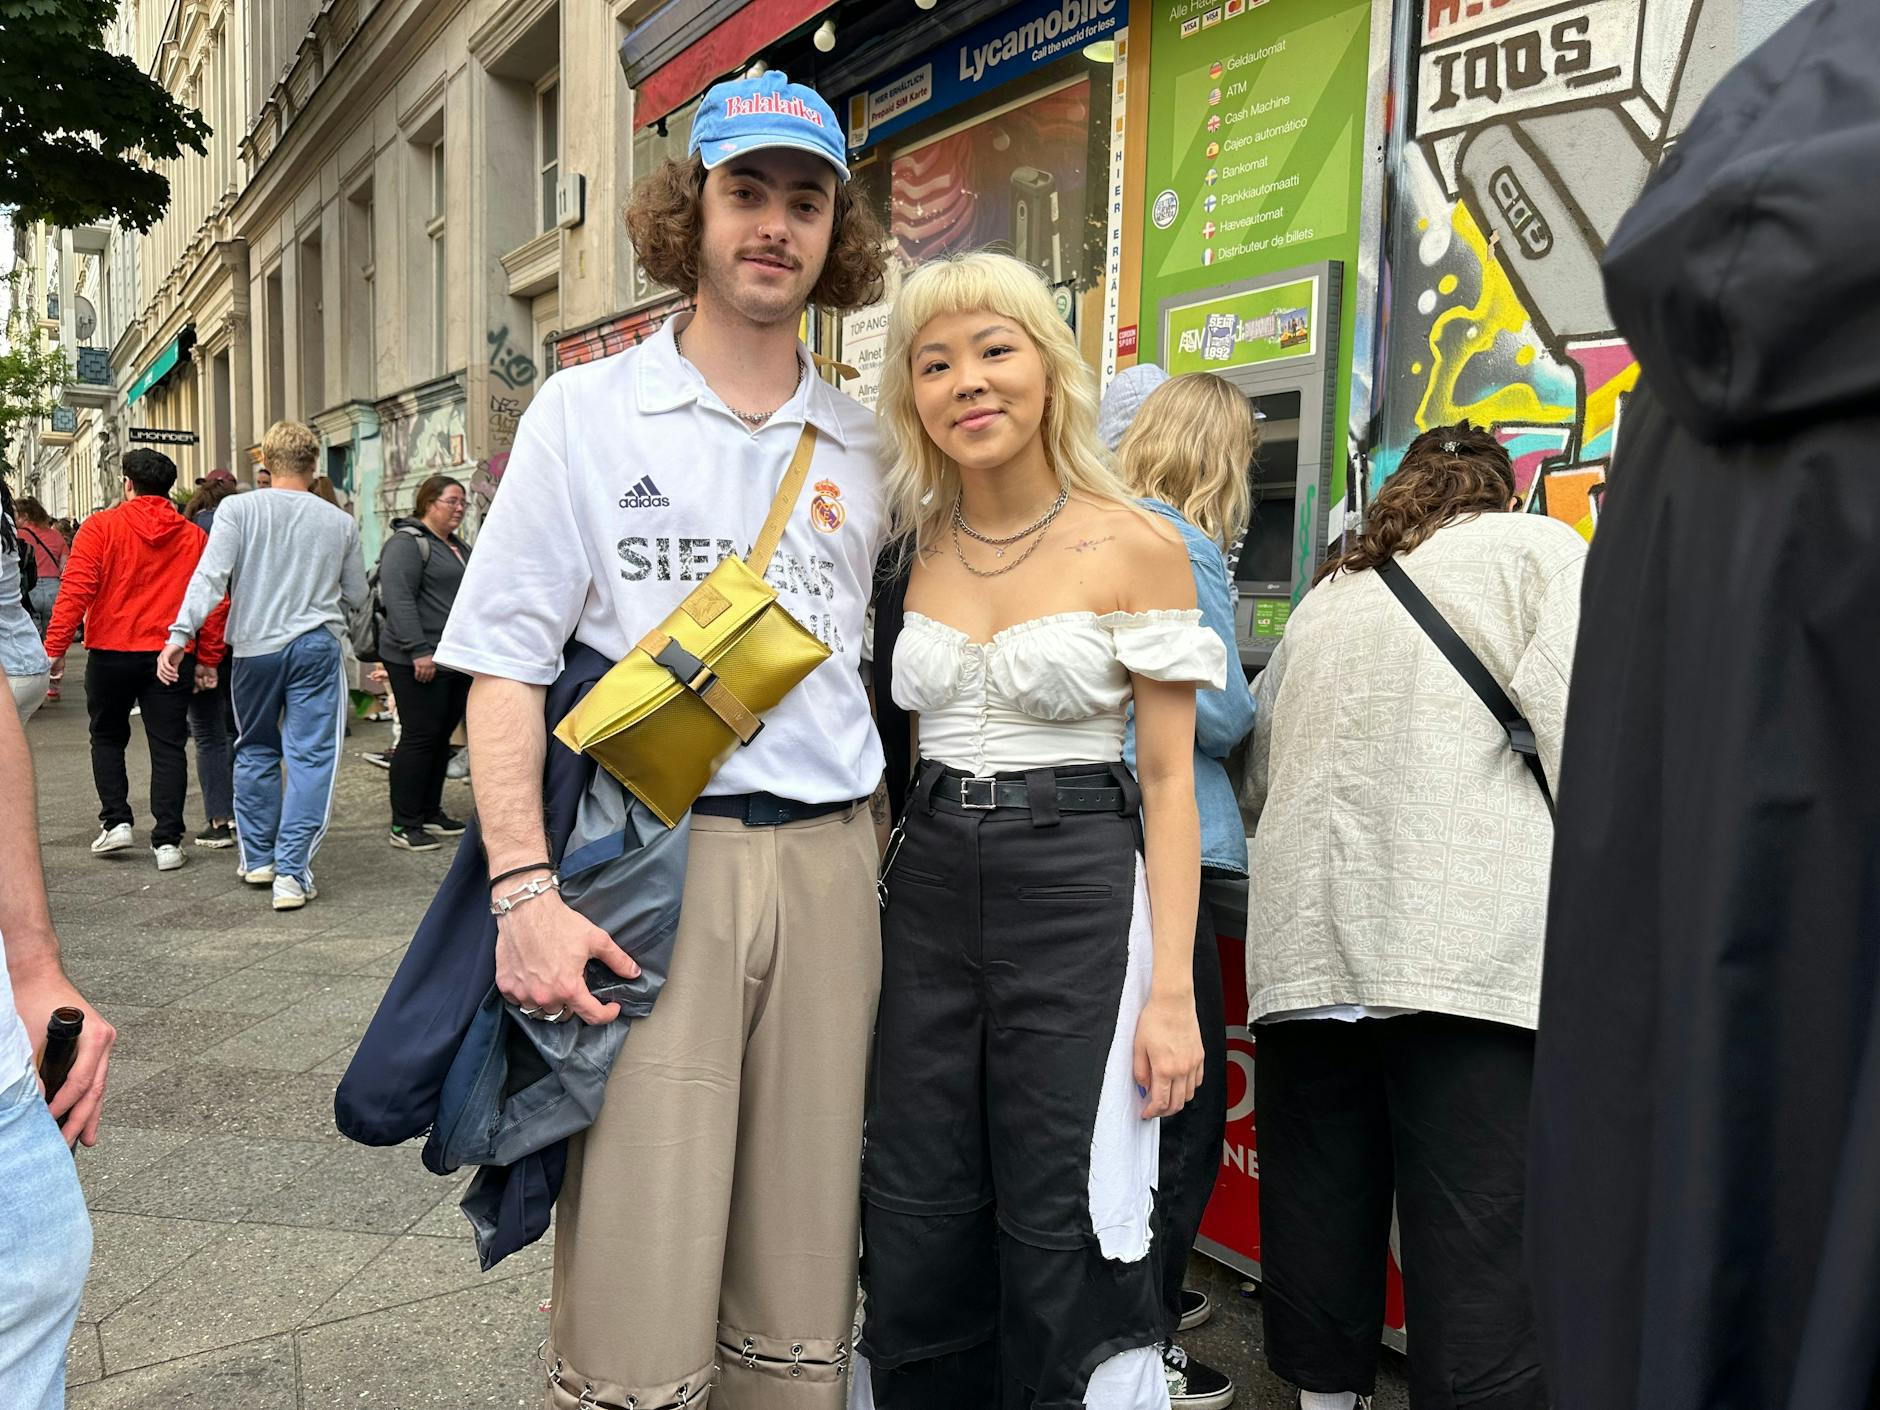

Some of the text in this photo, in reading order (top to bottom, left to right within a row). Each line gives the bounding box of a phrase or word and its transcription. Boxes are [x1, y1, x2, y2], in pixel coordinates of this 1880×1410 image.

[1169, 4, 1188, 21] Alle
[1202, 10, 1219, 22] VISA
[1031, 17, 1116, 62] Call the world for less
[1183, 21, 1197, 32] VISA
[959, 0, 1116, 82] Lycamobile
[1227, 40, 1287, 71] Geldautomat
[889, 72, 925, 98] ERHÄLTLICH
[1226, 80, 1248, 99] ATM
[724, 91, 825, 129] Balalaika
[871, 87, 928, 122] Prepaid SIM Karte
[1225, 95, 1291, 125] Cash Machine
[1223, 117, 1308, 152] Cajero automático
[1222, 156, 1268, 179] Bankomat
[1221, 173, 1300, 205] Pankkiautomaatti
[1220, 207, 1284, 232] Hæveautomat
[1218, 228, 1314, 260] Distributeur de billets
[850, 321, 866, 336] TOP
[858, 347, 881, 364] Allnet
[618, 495, 670, 509] adidas
